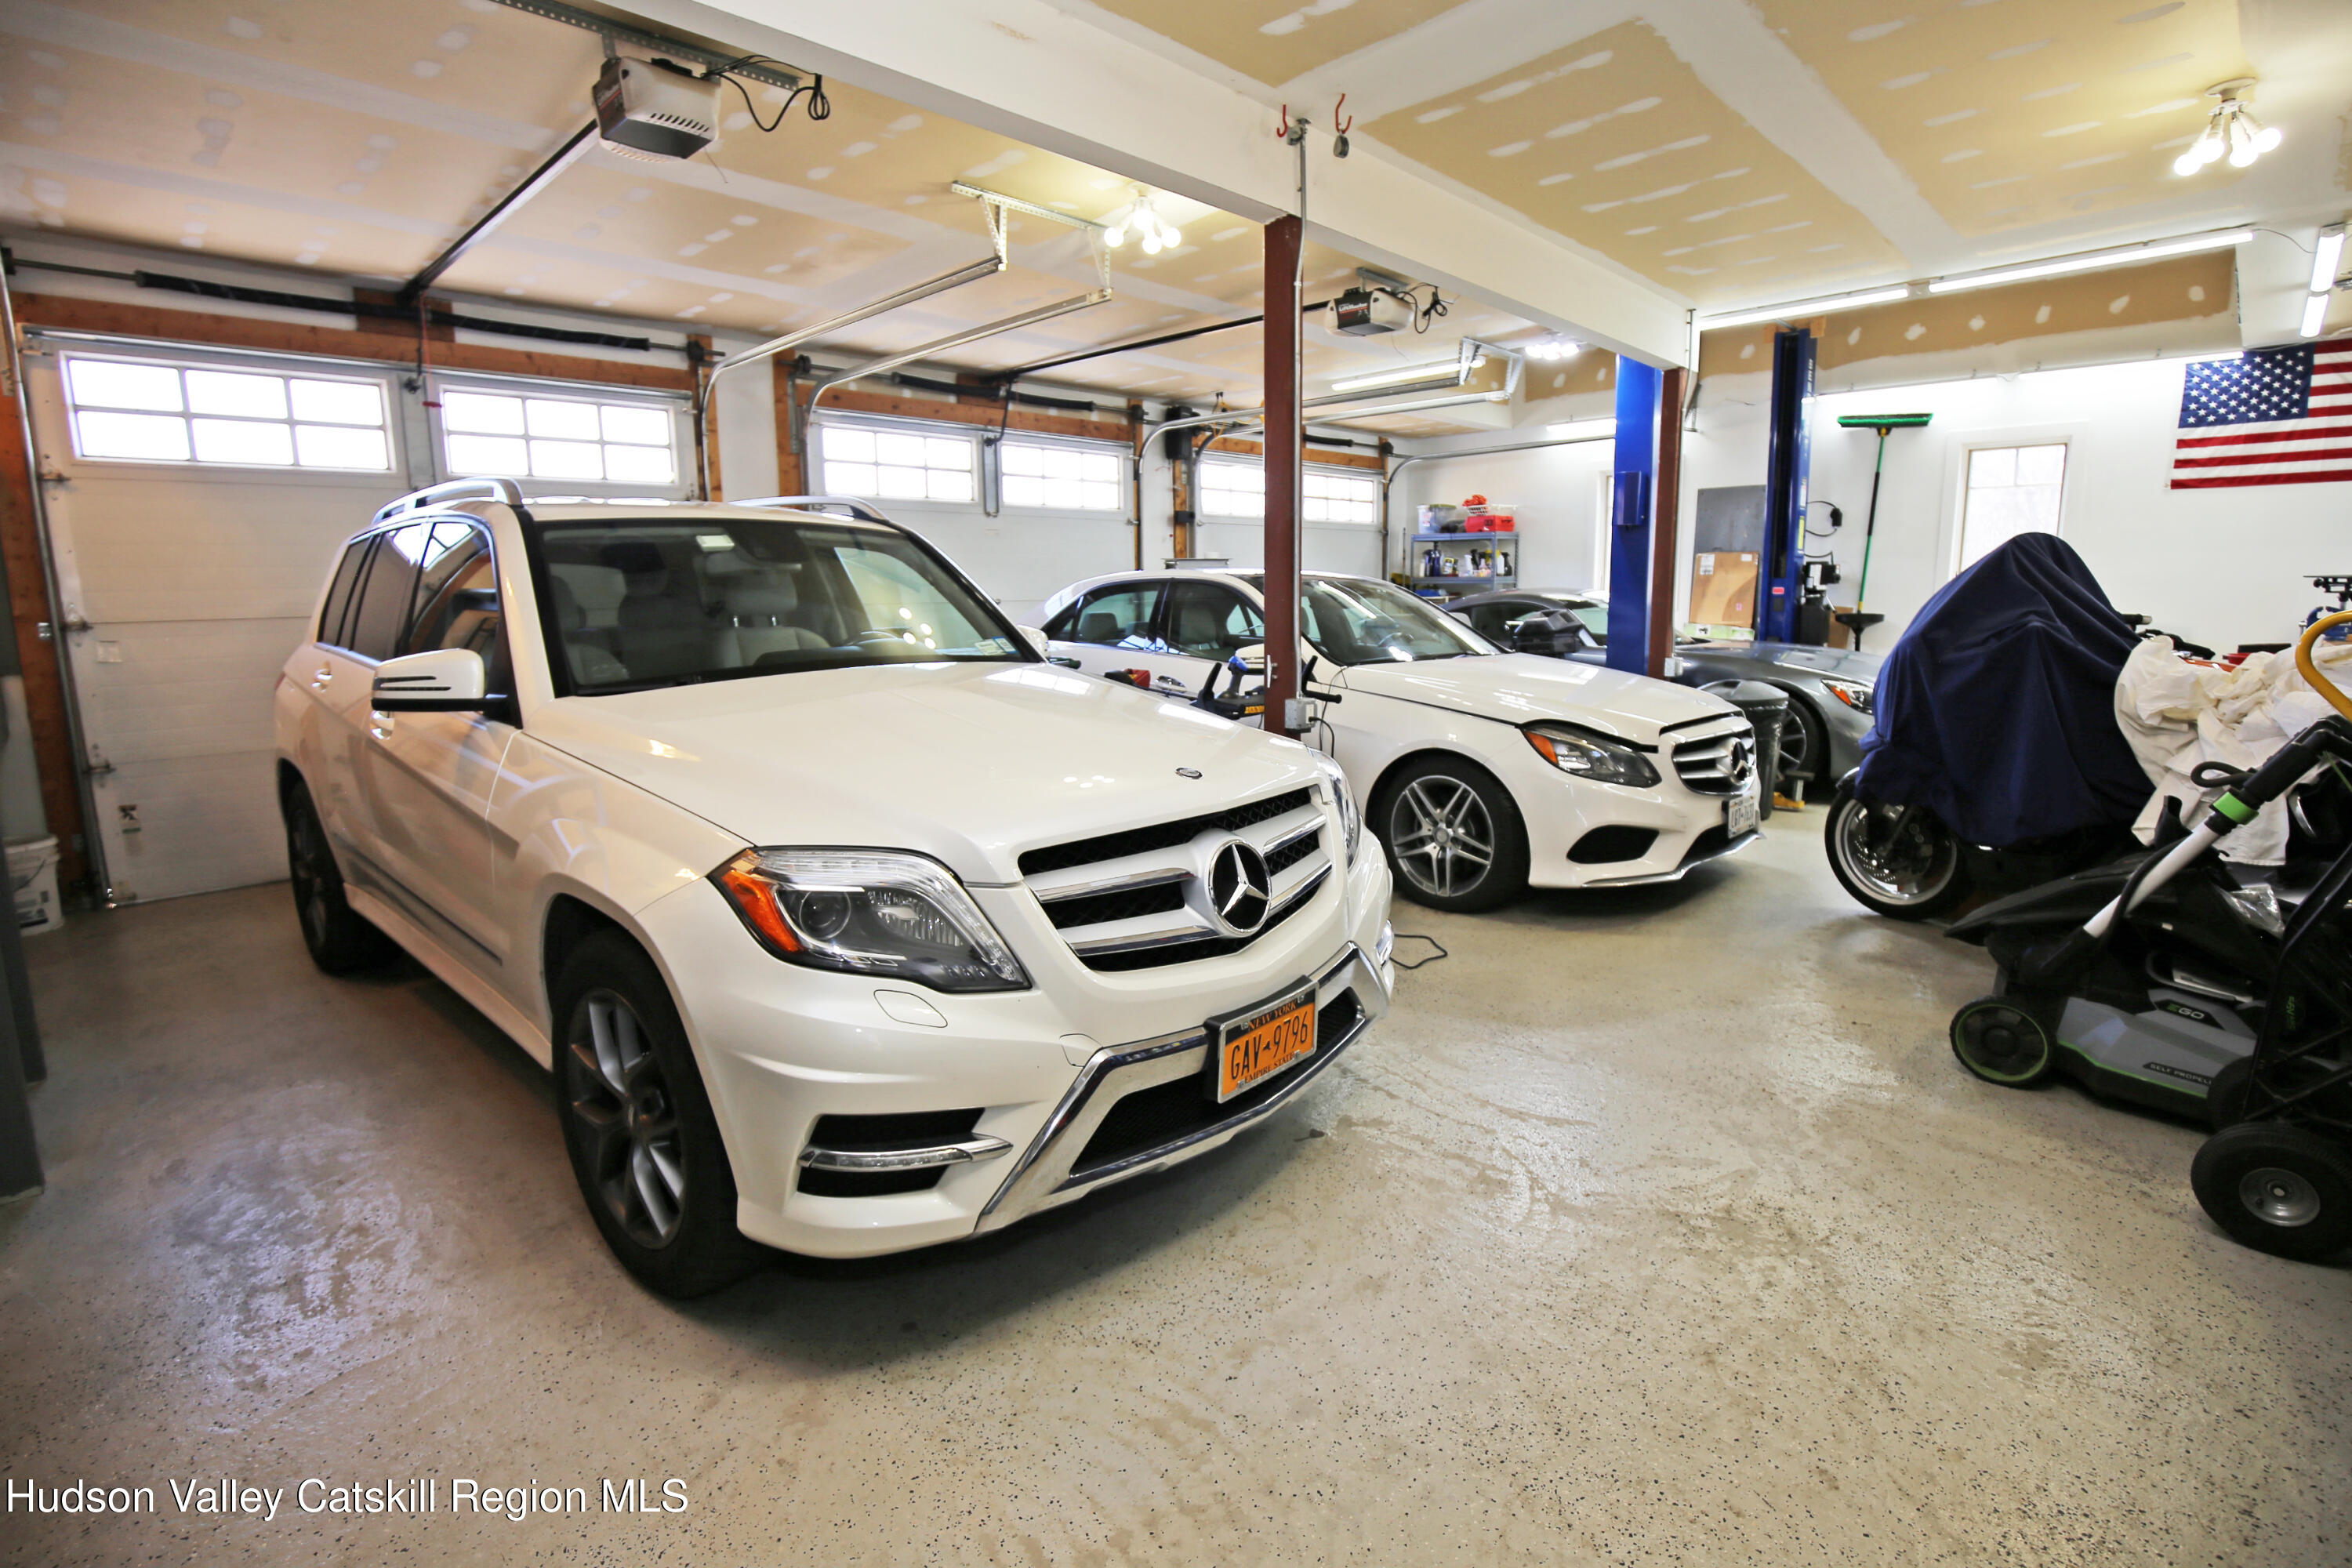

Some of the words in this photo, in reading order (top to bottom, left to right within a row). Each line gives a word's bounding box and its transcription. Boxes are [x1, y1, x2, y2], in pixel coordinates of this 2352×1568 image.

[1248, 1014, 1271, 1029] NEW
[1275, 1000, 1298, 1017] YORK
[2166, 1004, 2205, 1019] EGO
[1244, 1064, 1271, 1083] EMPIRE
[2150, 1063, 2172, 1073] SELF
